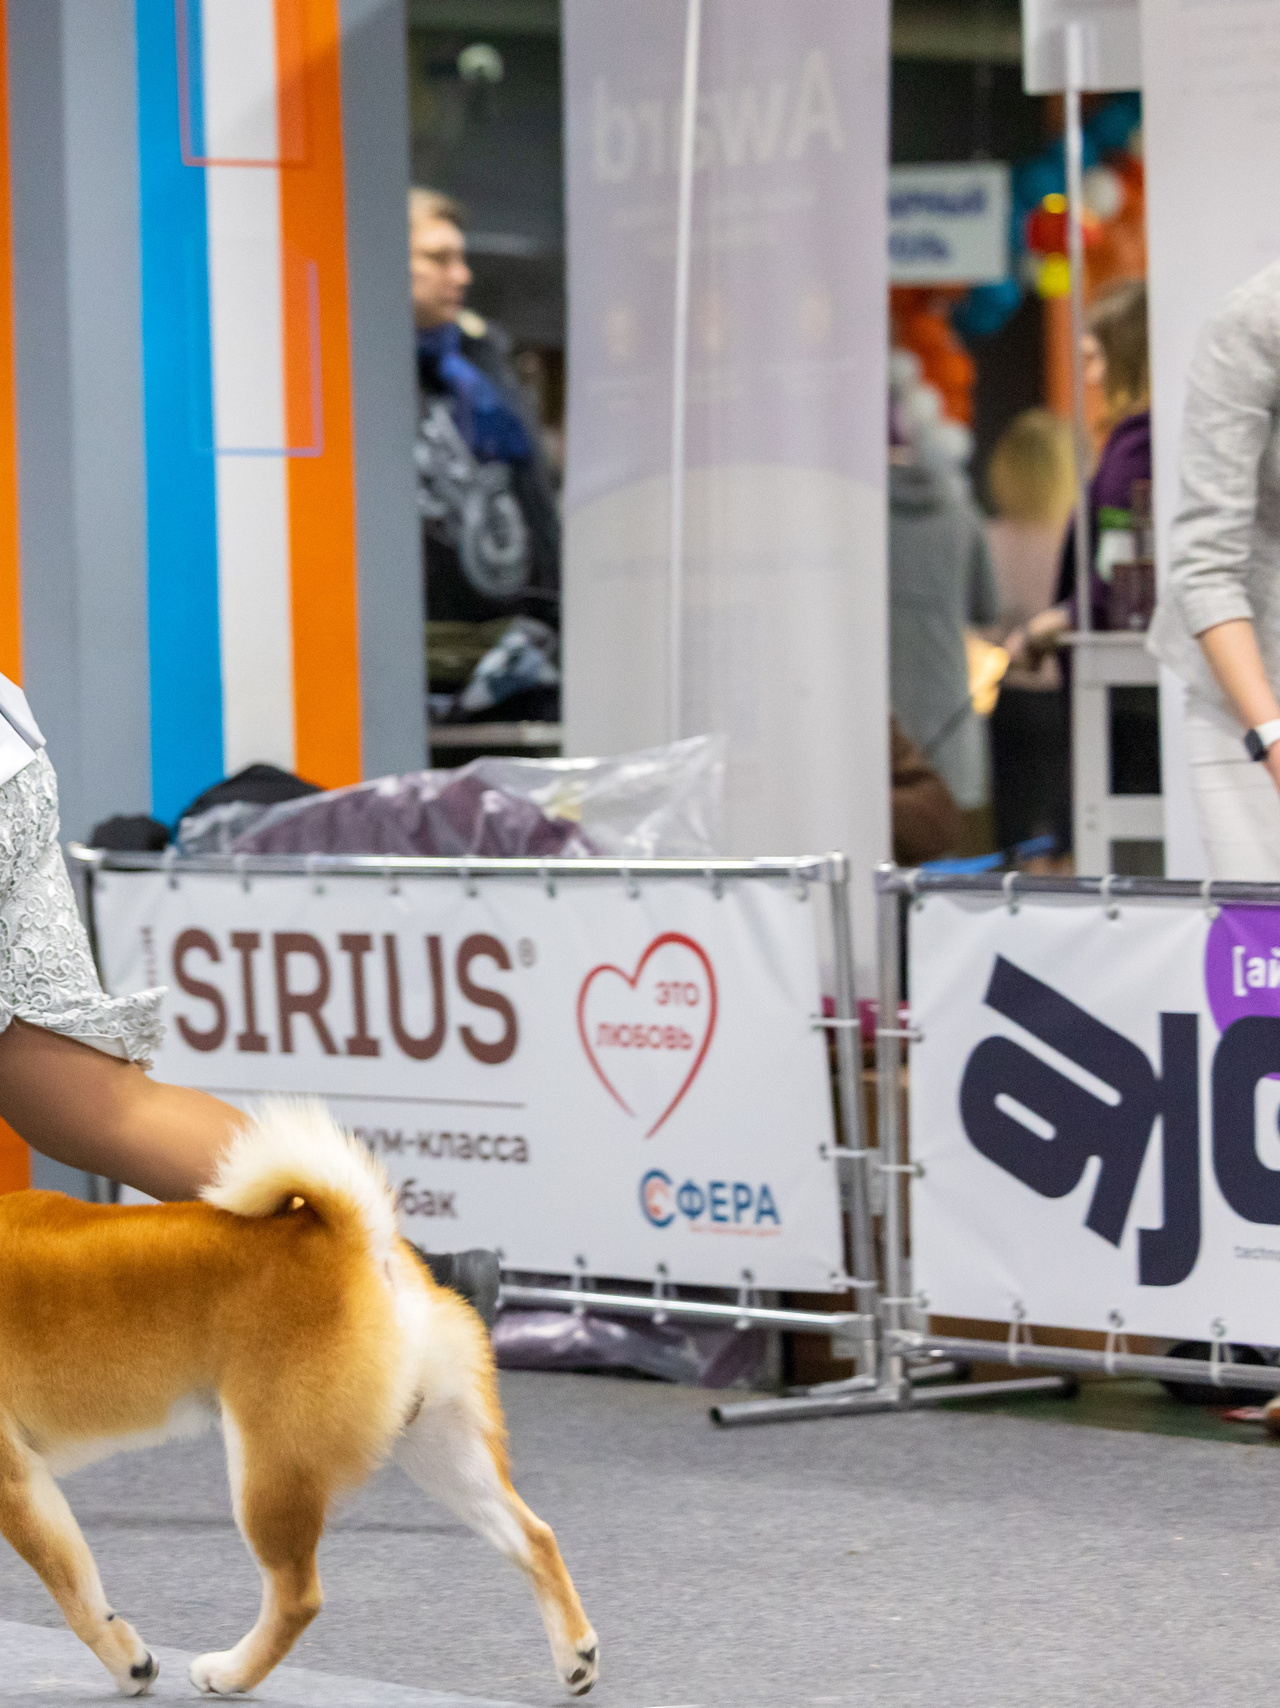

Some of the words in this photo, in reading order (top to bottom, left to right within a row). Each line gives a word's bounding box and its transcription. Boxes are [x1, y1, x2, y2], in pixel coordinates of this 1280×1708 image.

[655, 981, 699, 1006] ЭТО
[596, 1023, 693, 1050] ЛЮБОВЬ
[394, 1178, 458, 1219] бак
[638, 1168, 782, 1229] СФЕРА
